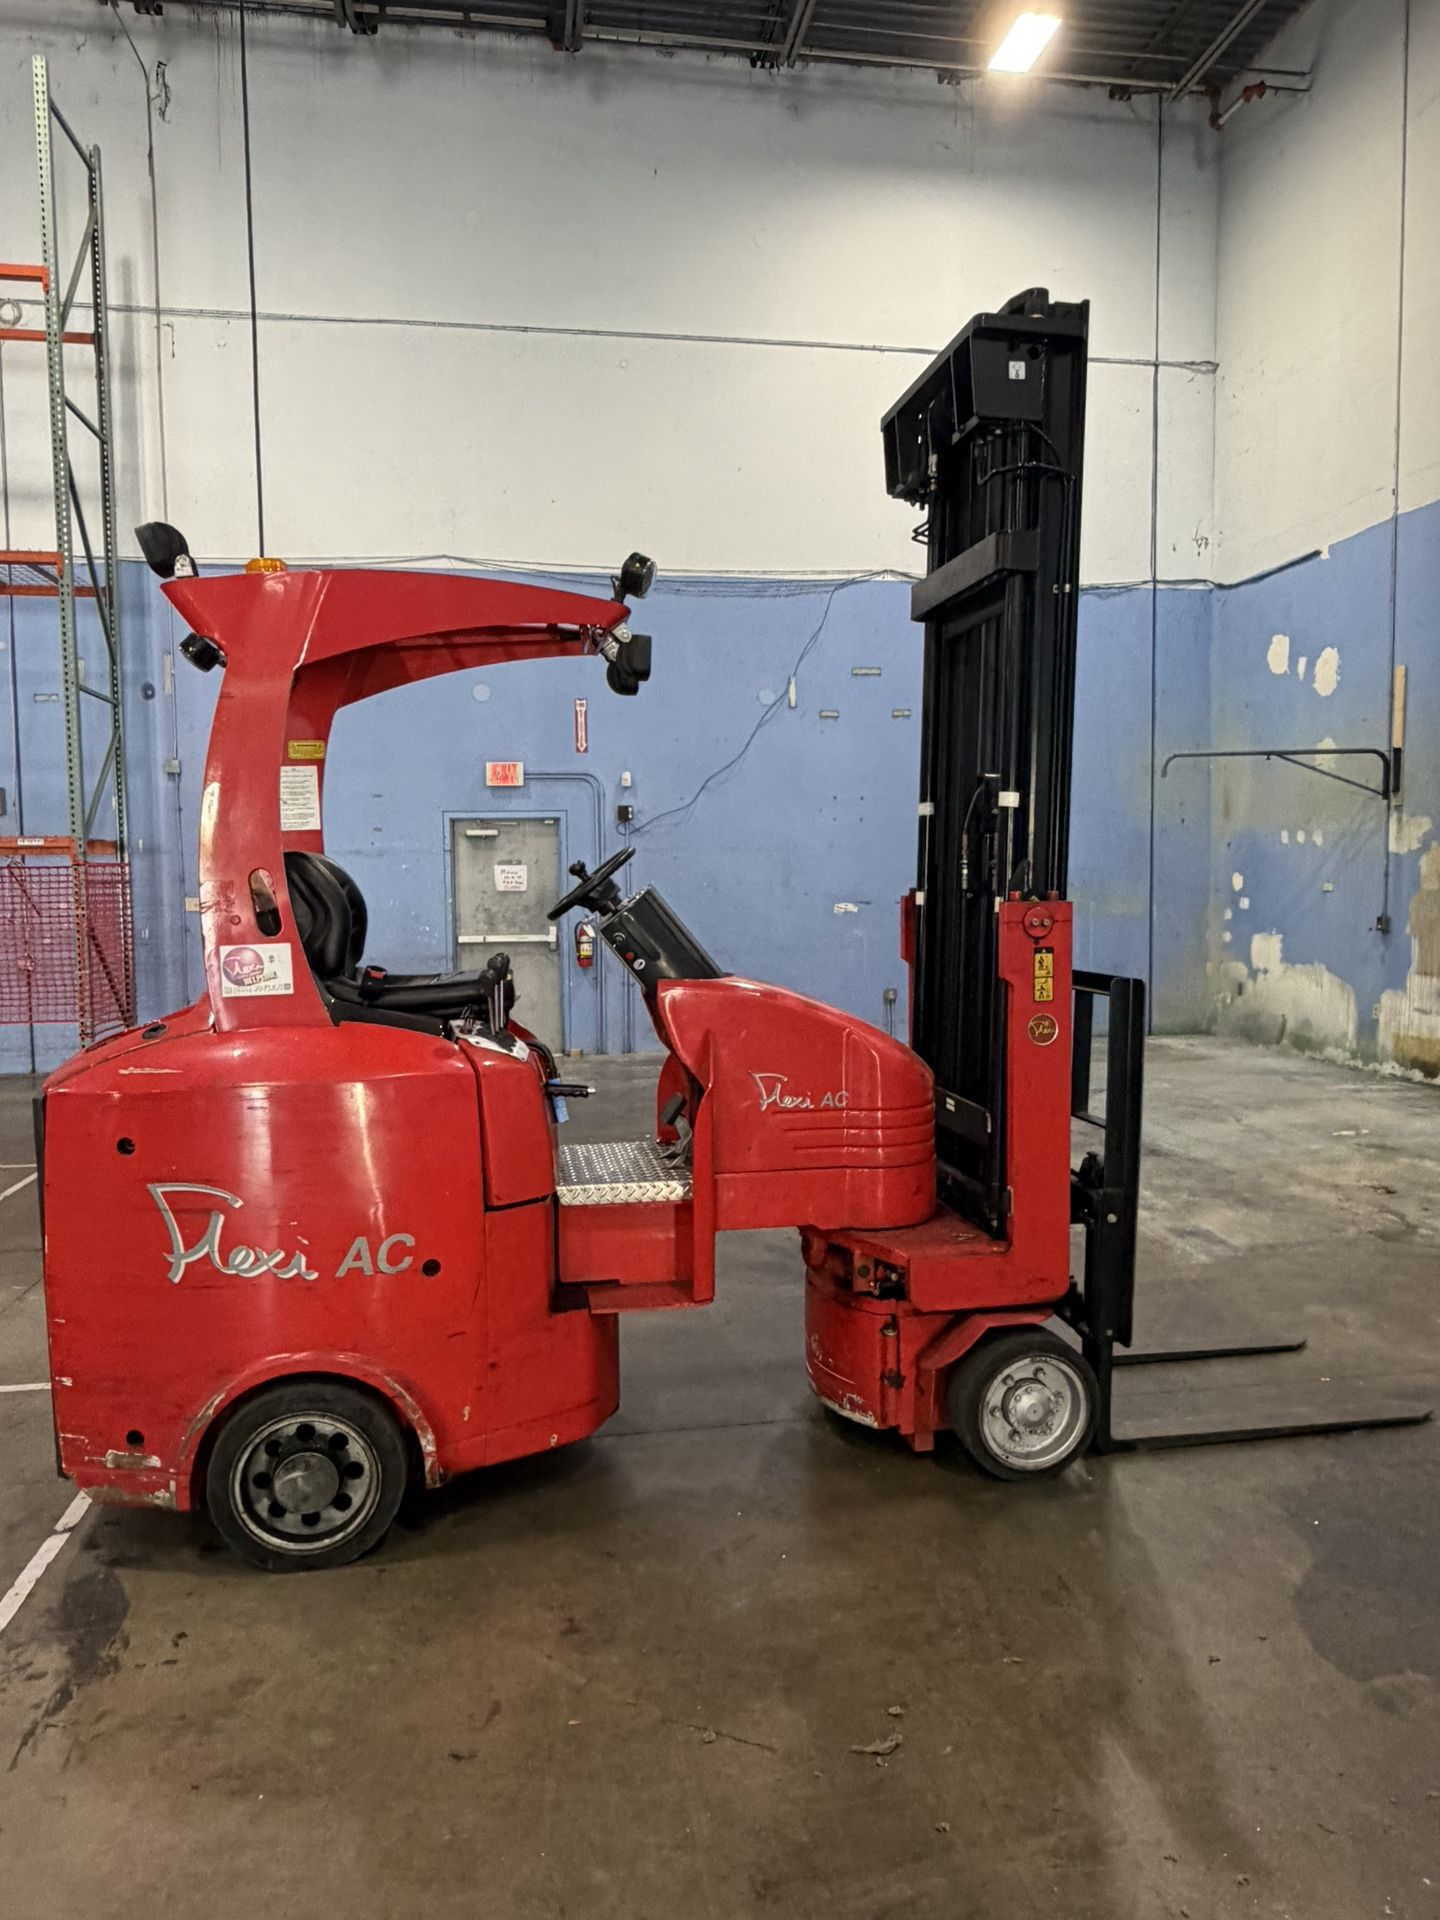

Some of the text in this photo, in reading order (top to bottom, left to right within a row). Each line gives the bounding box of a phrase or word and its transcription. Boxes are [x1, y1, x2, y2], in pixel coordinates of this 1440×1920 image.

[750, 1072, 849, 1112] Flexi AC
[146, 1183, 416, 1284] Flexi AC
